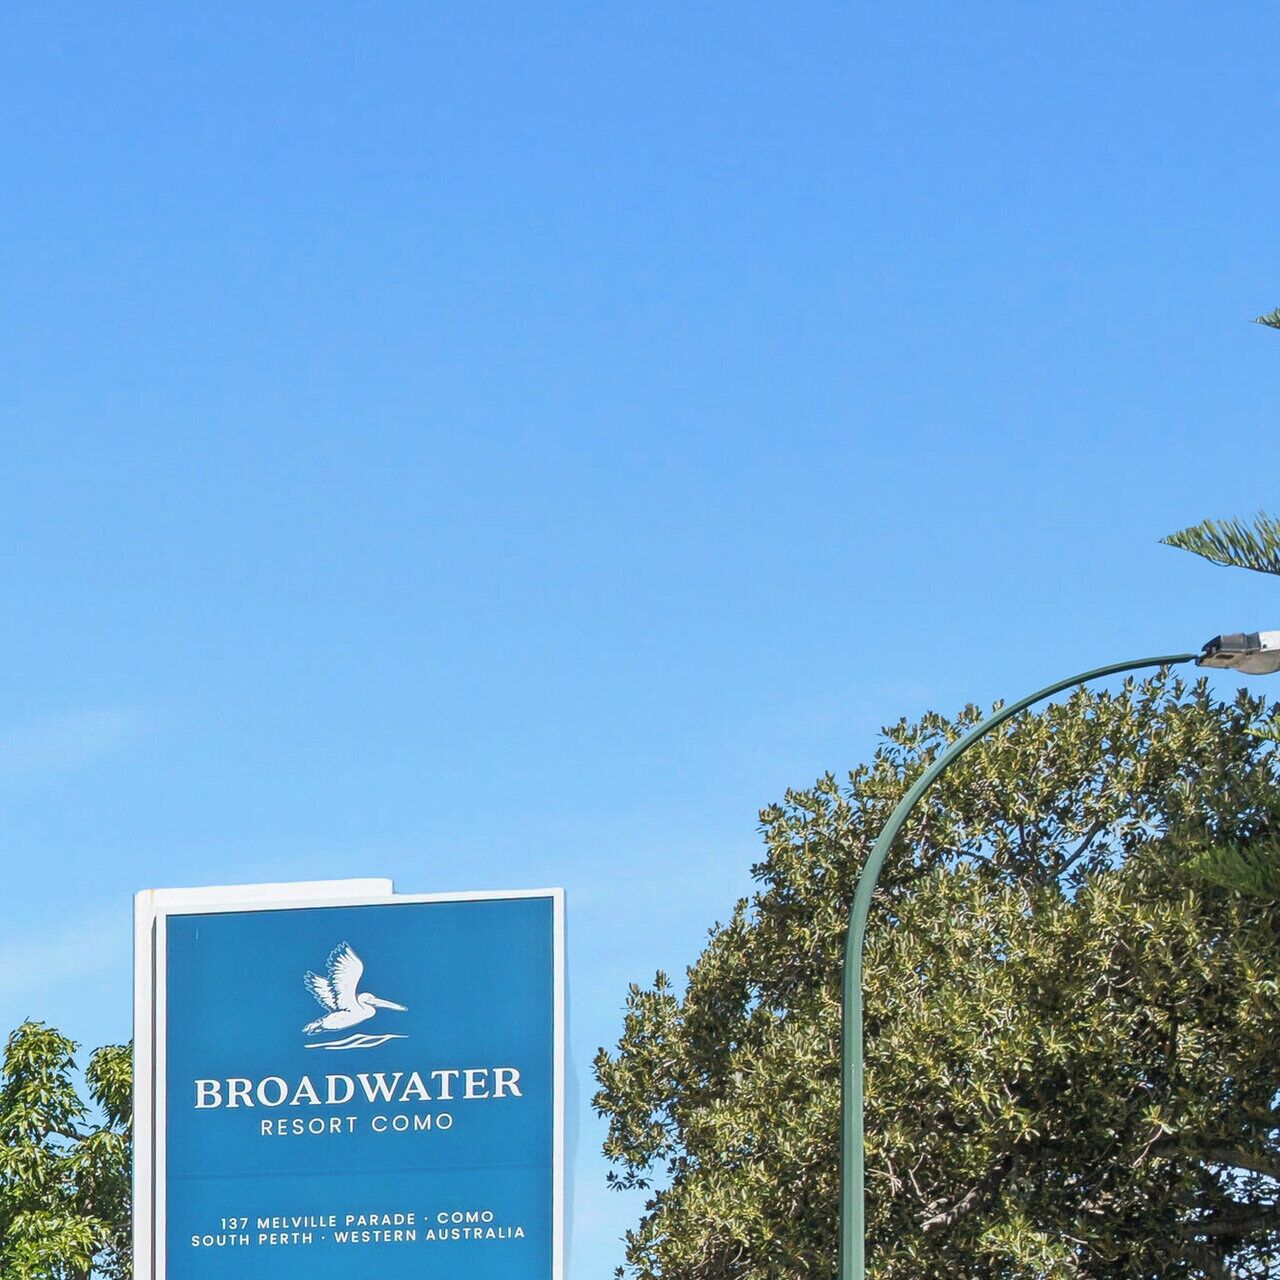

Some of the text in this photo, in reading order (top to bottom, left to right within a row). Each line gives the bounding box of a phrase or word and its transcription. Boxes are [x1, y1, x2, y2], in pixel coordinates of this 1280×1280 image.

[194, 1067, 523, 1109] BROADWATER
[261, 1113, 454, 1136] RESORT COMO
[220, 1210, 494, 1230] 137 MELVILLE PARADE COMO
[191, 1226, 525, 1247] SOUTH PERTH WESTERN AUSTRALIA
